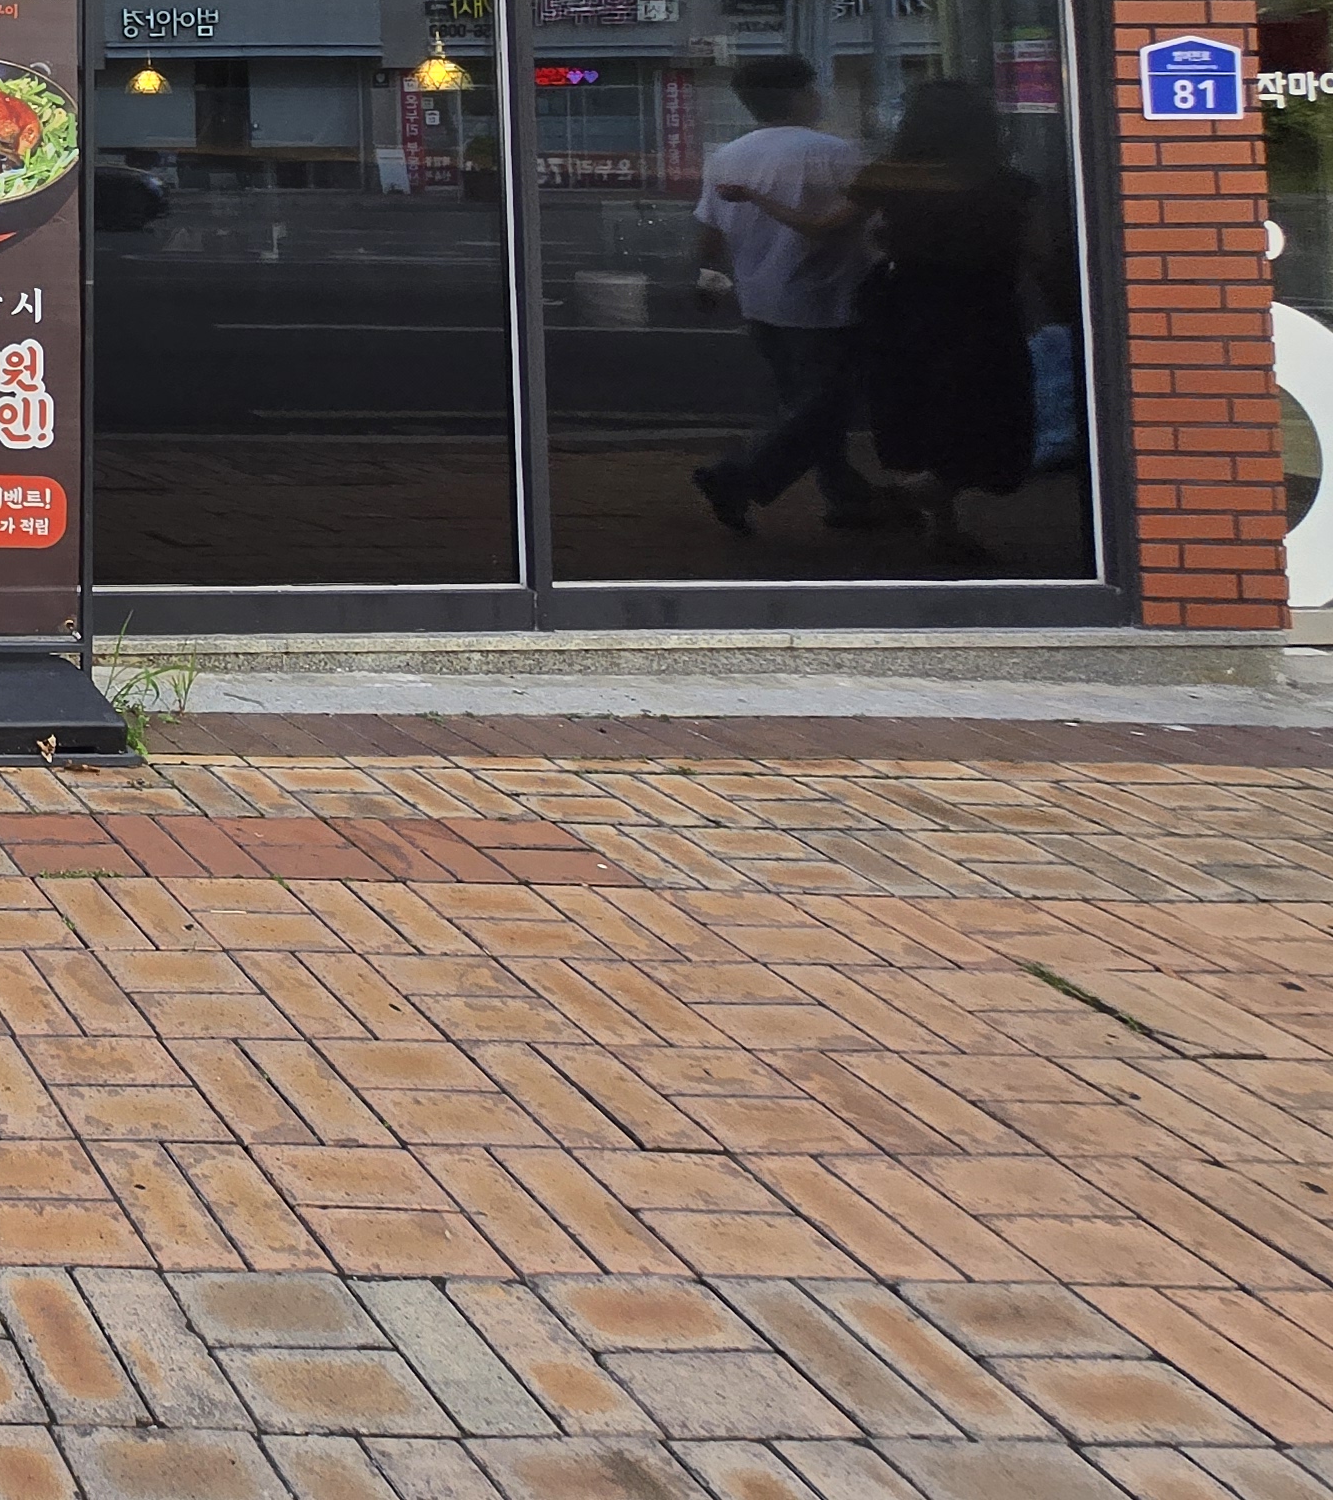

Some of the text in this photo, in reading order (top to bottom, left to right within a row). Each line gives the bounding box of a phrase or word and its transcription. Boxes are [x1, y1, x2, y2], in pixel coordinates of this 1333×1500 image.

[1173, 79, 1216, 110] 81
[10, 287, 43, 324] 시
[19, 517, 50, 536] 적립
